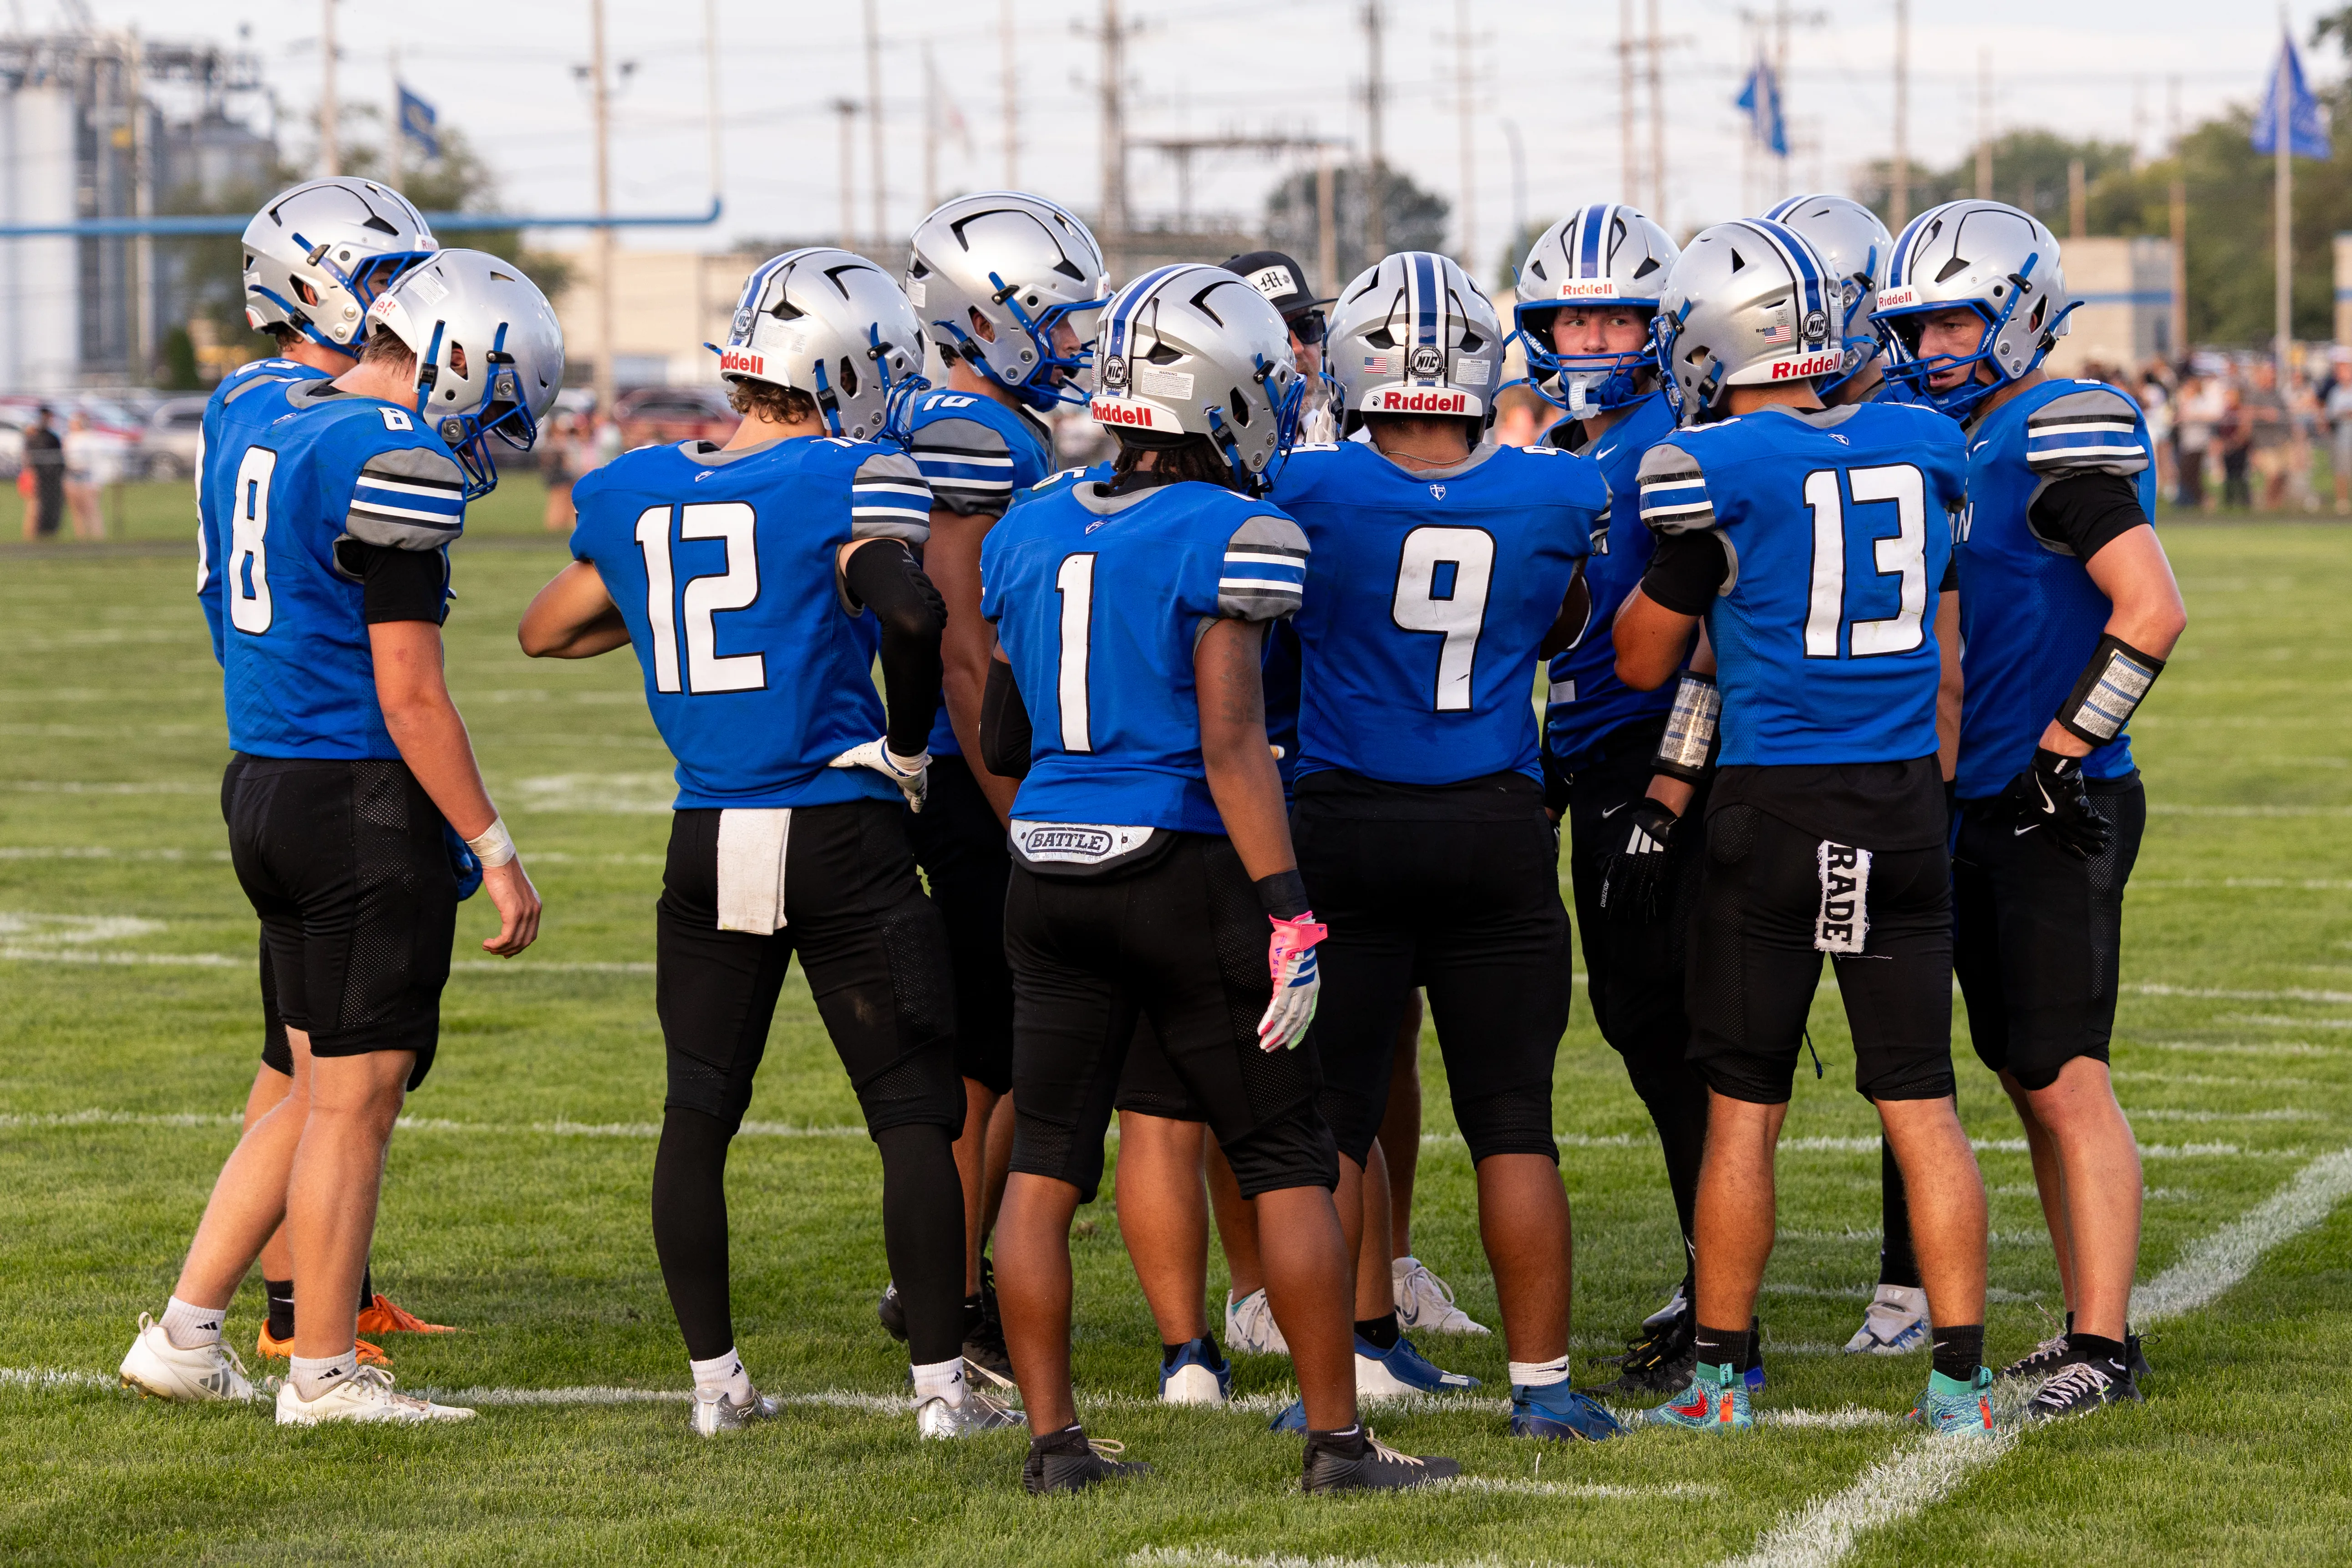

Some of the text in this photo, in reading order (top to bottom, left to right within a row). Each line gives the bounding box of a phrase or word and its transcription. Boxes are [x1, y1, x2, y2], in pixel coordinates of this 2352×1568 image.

[1563, 284, 1612, 295] Riddell
[1879, 291, 1912, 307] Riddell
[1107, 365, 1123, 378] NIC
[1416, 356, 1438, 368] NIC
[1772, 353, 1841, 380] Riddell
[1092, 401, 1153, 427] Riddell
[1384, 392, 1465, 412] Riddell
[376, 407, 415, 431] 8
[228, 444, 278, 636] 8
[1803, 462, 1928, 660] 13
[634, 500, 769, 696] 12
[1390, 523, 1498, 713] 9
[1054, 551, 1099, 754] 1
[1031, 832, 1104, 851] BATTLE
[1600, 879, 1609, 908] ADIZERO
[1822, 844, 1858, 943] RADE
